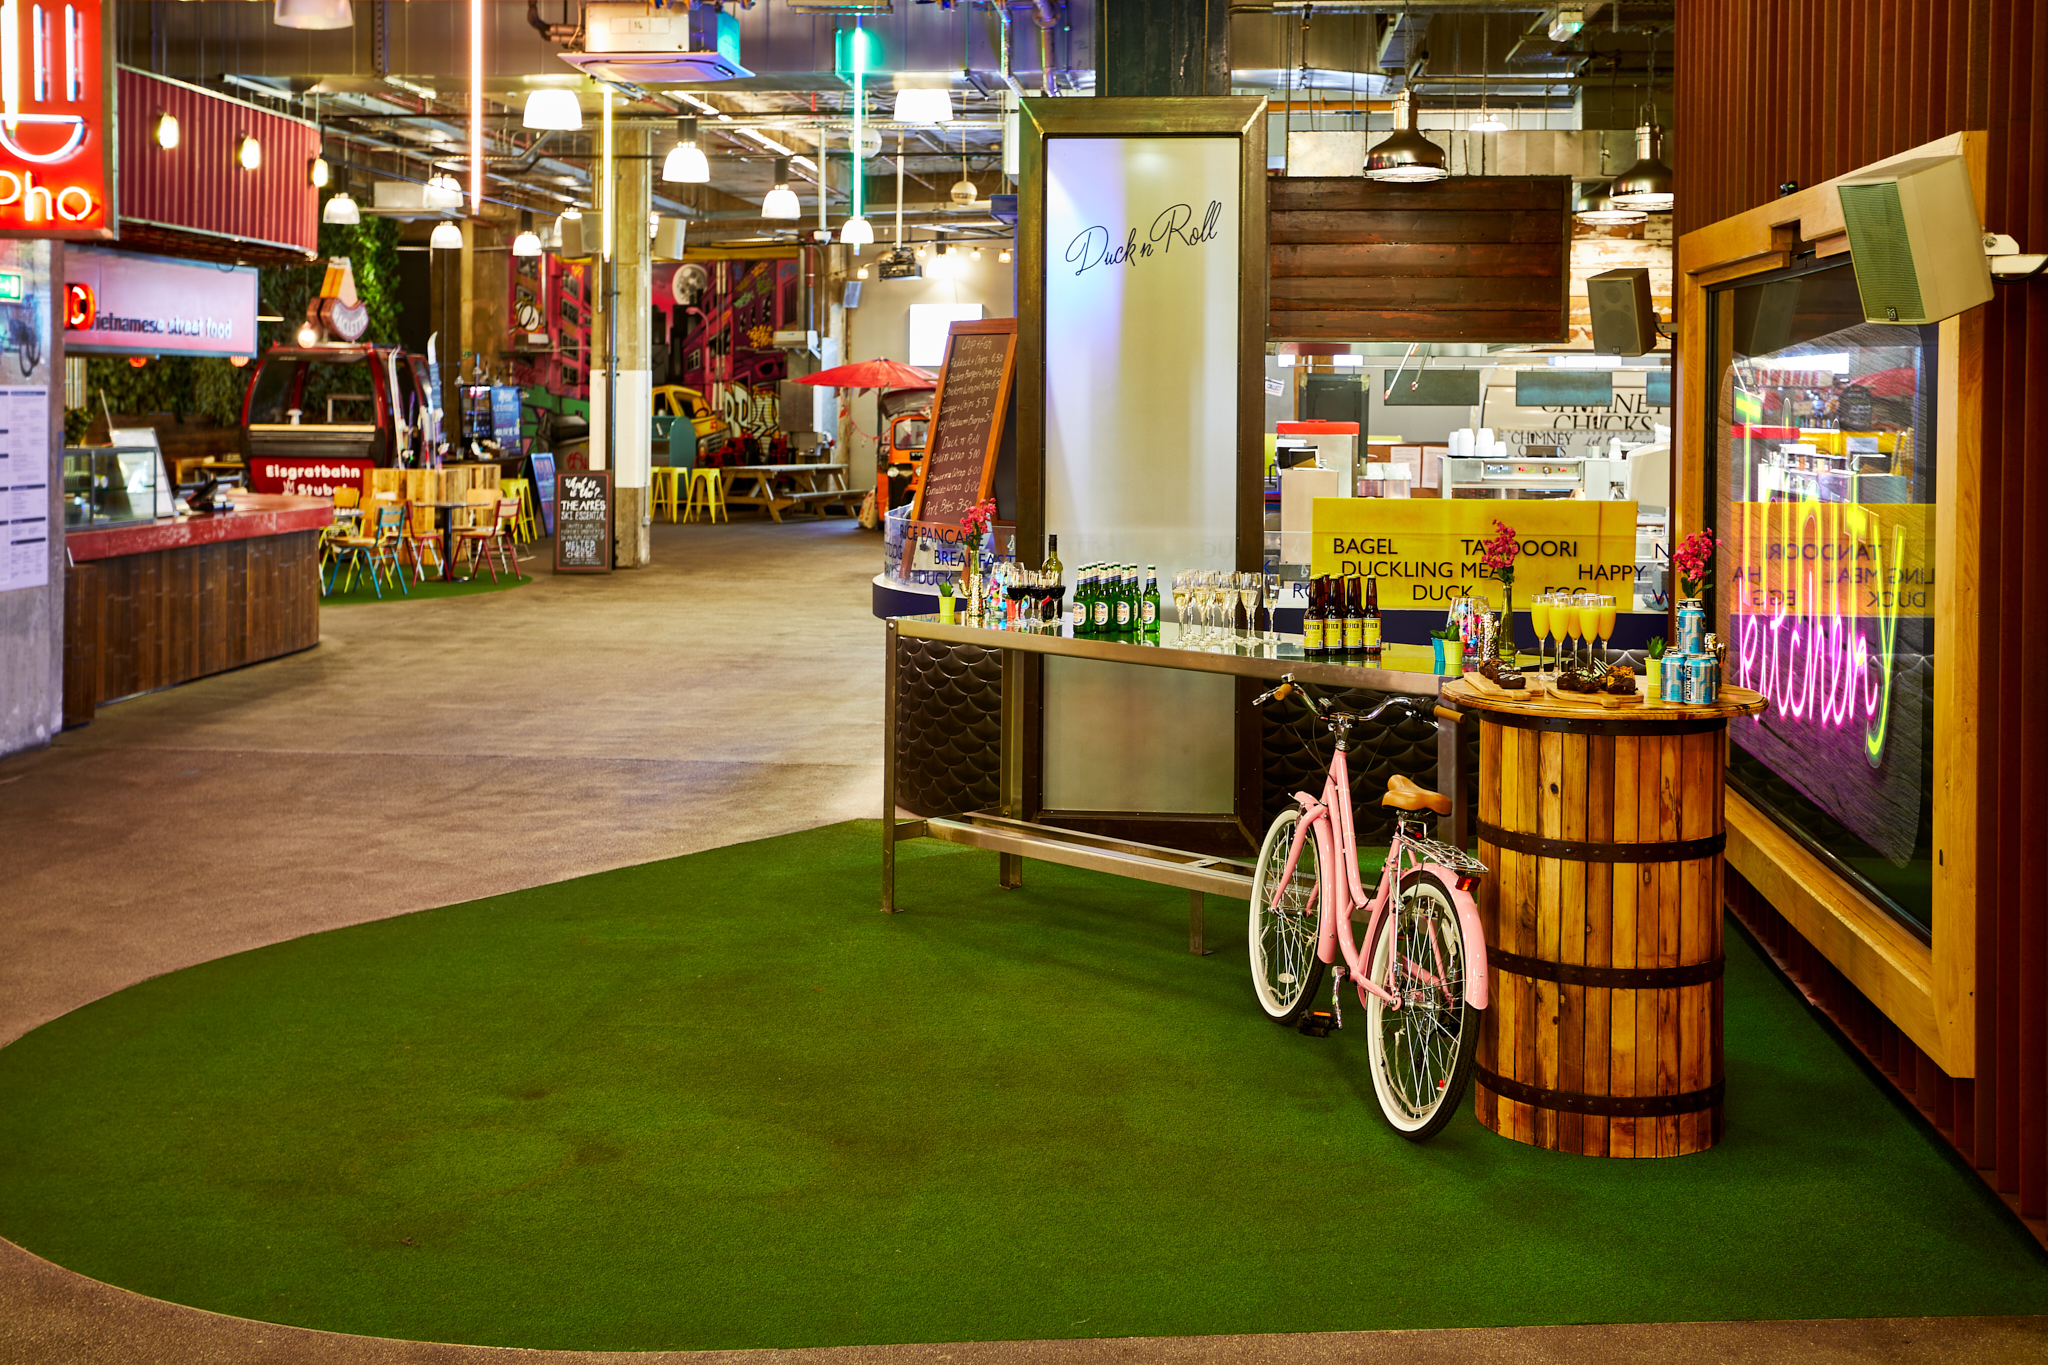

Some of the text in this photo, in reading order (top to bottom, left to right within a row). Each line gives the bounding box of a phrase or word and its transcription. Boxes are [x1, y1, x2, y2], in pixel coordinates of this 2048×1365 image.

[1065, 225, 1136, 276] Duck
[1149, 200, 1222, 254] Roll
[92, 311, 232, 339] ietnamese street food
[297, 483, 347, 496] Stub
[561, 500, 579, 511] THE
[1333, 537, 1398, 555] BAGEL
[1461, 540, 1577, 557] TAOORI
[1341, 560, 1646, 581] DUCKLING MEA HAPPY
[1413, 584, 1473, 601] DUCK
[1738, 570, 1879, 726] kitchen
